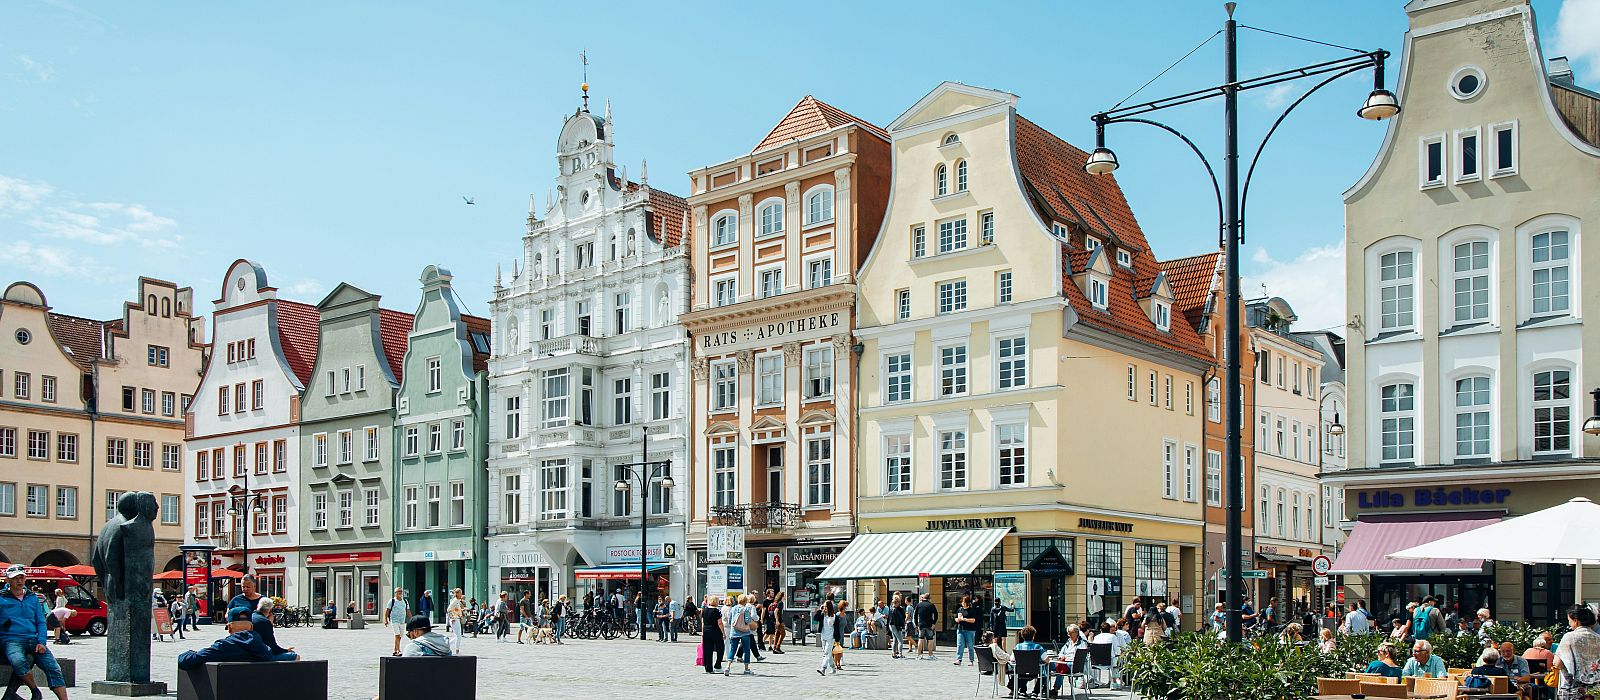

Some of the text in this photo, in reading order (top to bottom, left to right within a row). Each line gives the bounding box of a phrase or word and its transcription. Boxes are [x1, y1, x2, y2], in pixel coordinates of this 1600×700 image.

[703, 312, 840, 348] RATS APOTHEKE
[1358, 487, 1512, 508] Lila Bäcker
[926, 516, 1016, 530] JUWELIER WITT
[1078, 517, 1134, 532] JUWELIER WITT
[501, 553, 545, 564] FESTMODE
[610, 549, 635, 557] ROSTOCK
